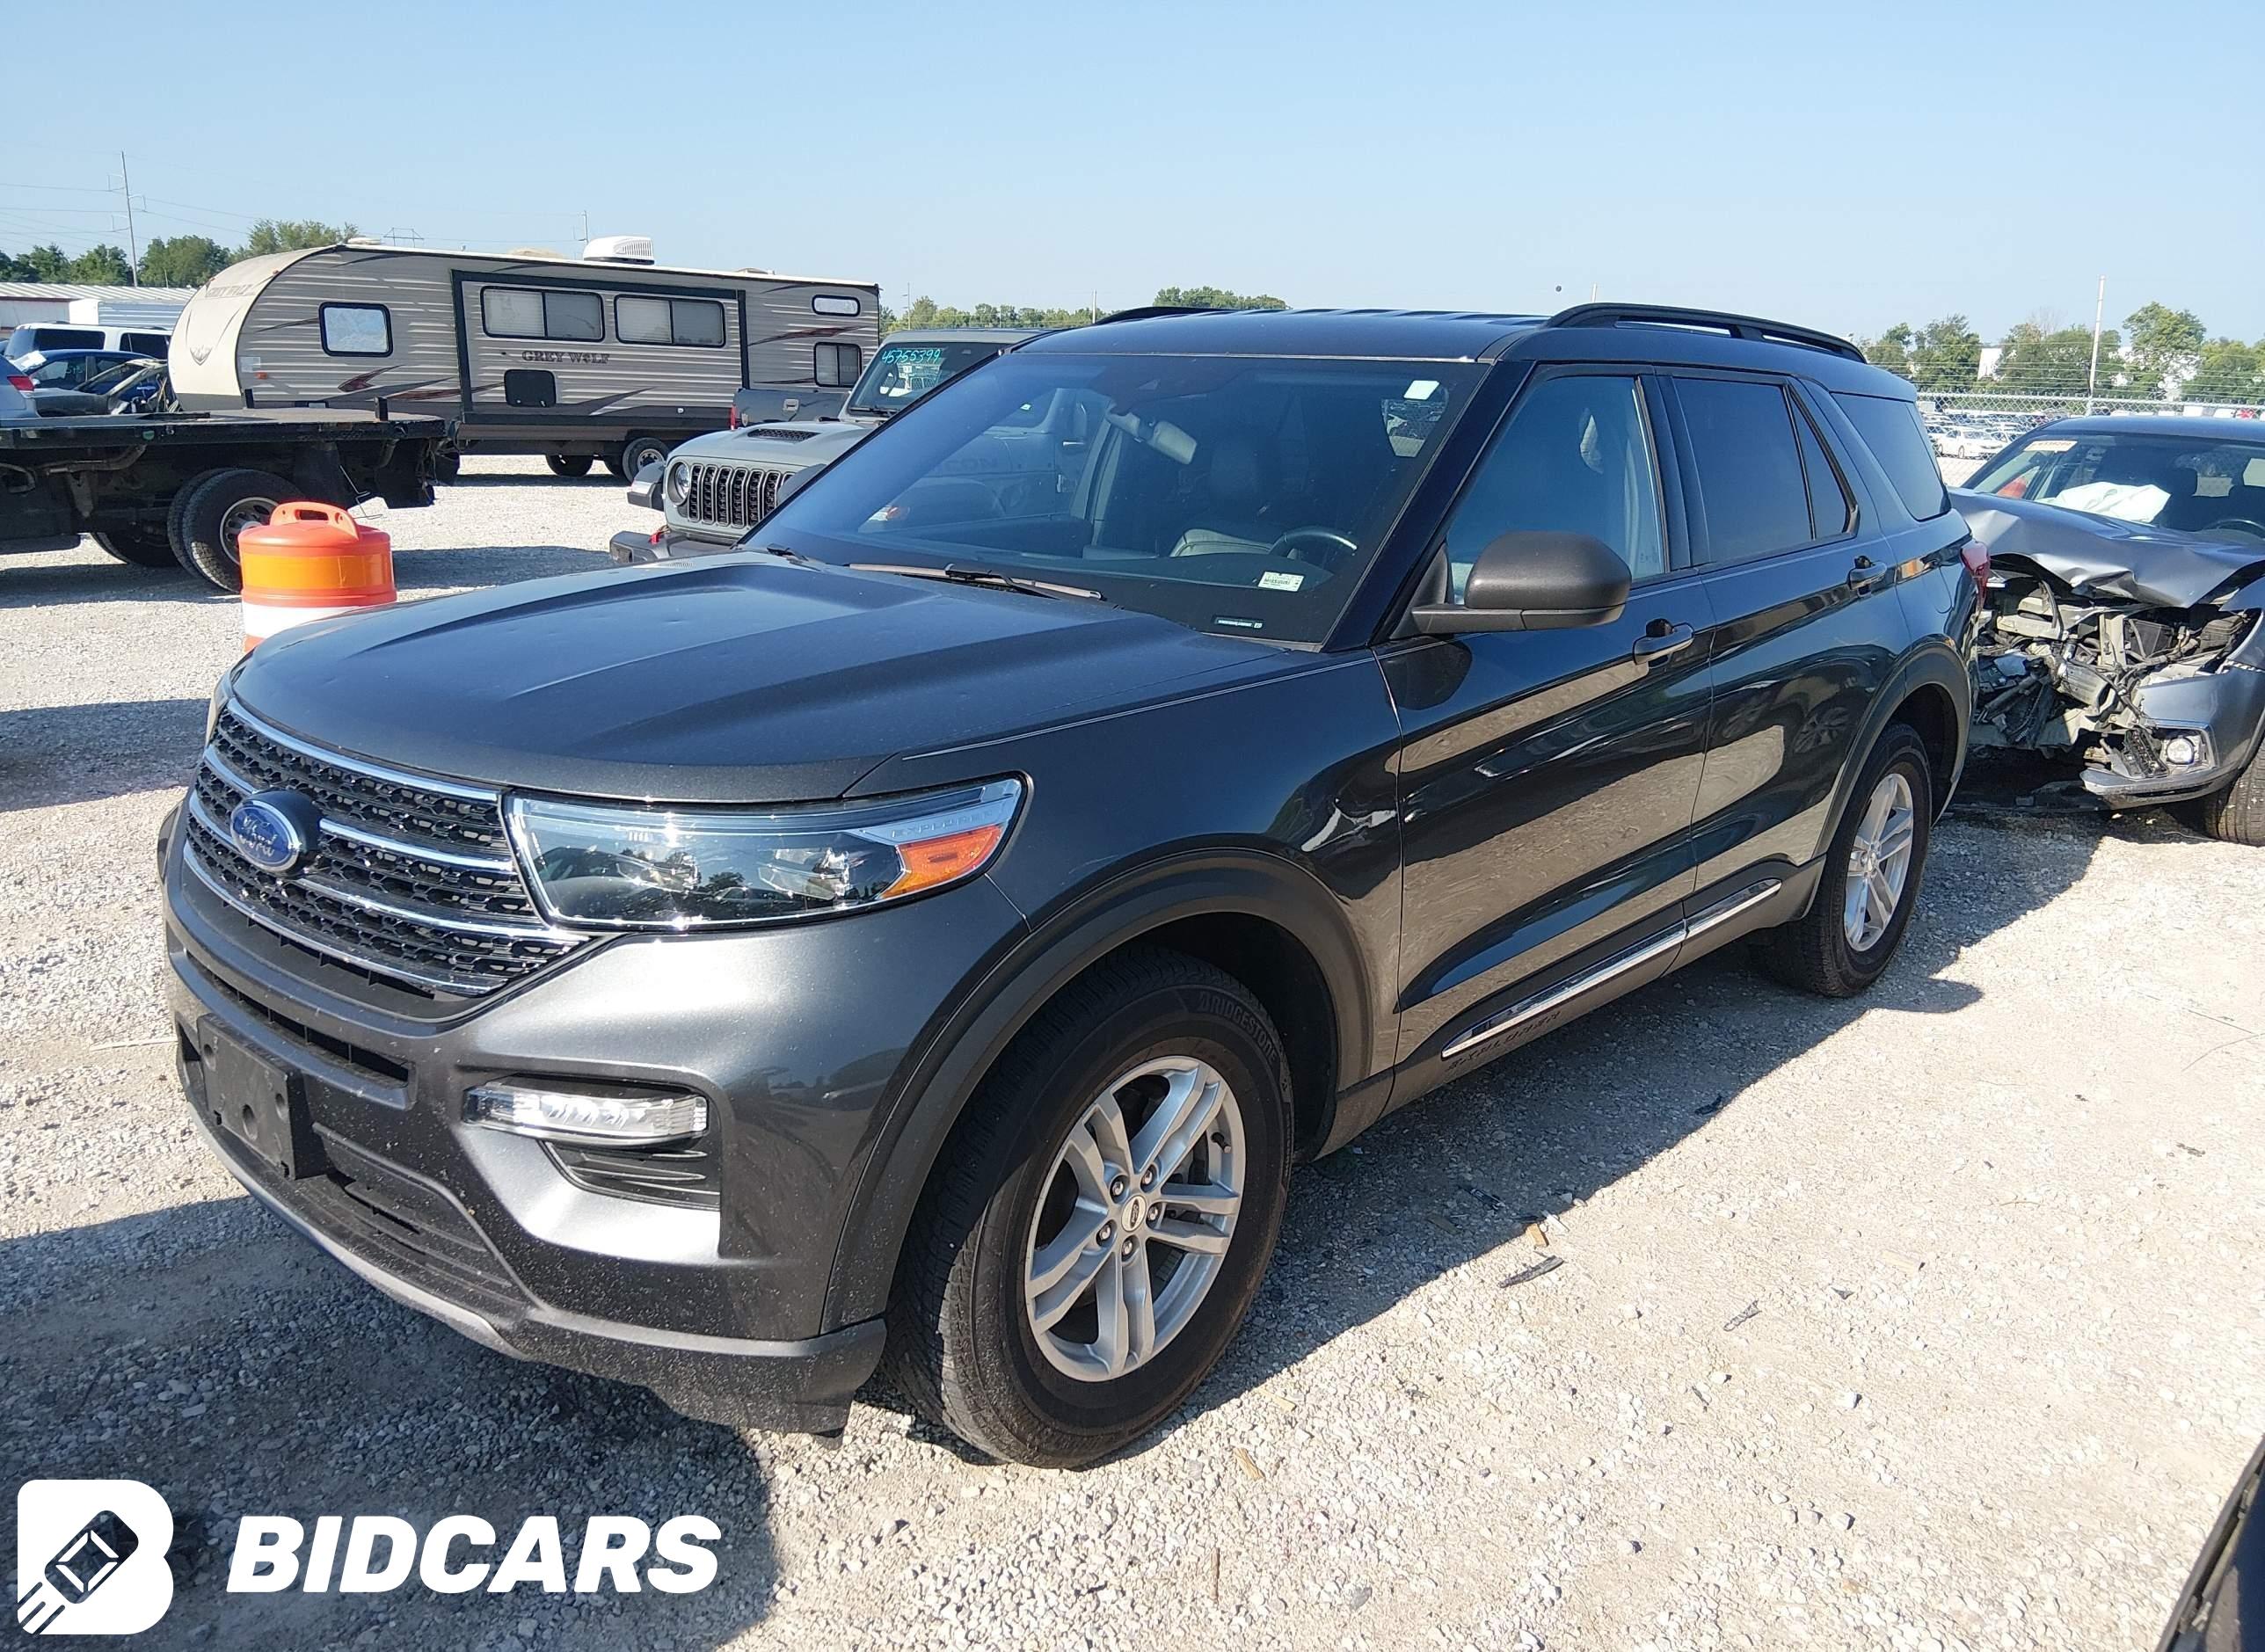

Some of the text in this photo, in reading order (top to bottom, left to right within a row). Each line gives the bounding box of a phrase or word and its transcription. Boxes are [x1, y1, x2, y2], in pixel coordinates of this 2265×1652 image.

[521, 351, 610, 364] GREY WOLF
[1198, 991, 1278, 1065] BRIDGESTONE
